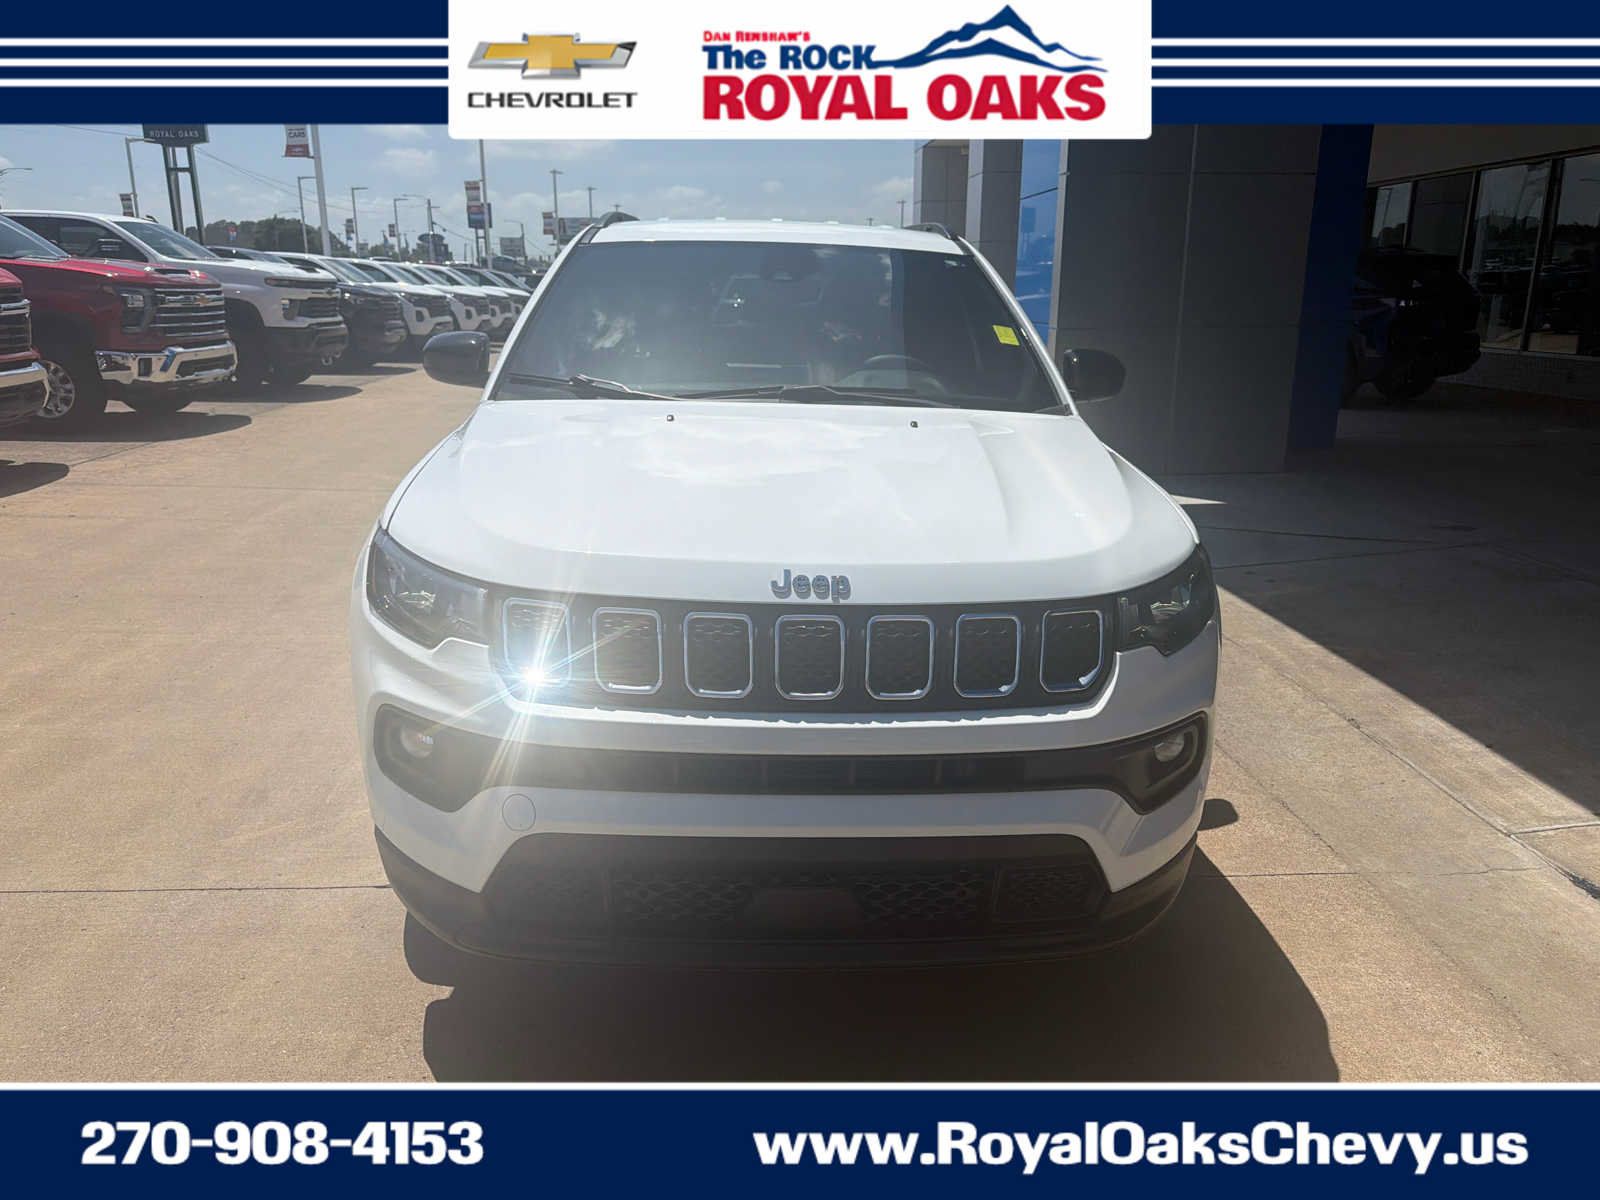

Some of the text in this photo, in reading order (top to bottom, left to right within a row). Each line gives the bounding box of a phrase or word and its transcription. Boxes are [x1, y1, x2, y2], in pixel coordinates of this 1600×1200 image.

[149, 129, 200, 138] ROYAL OAKS
[770, 569, 851, 604] Jeep
